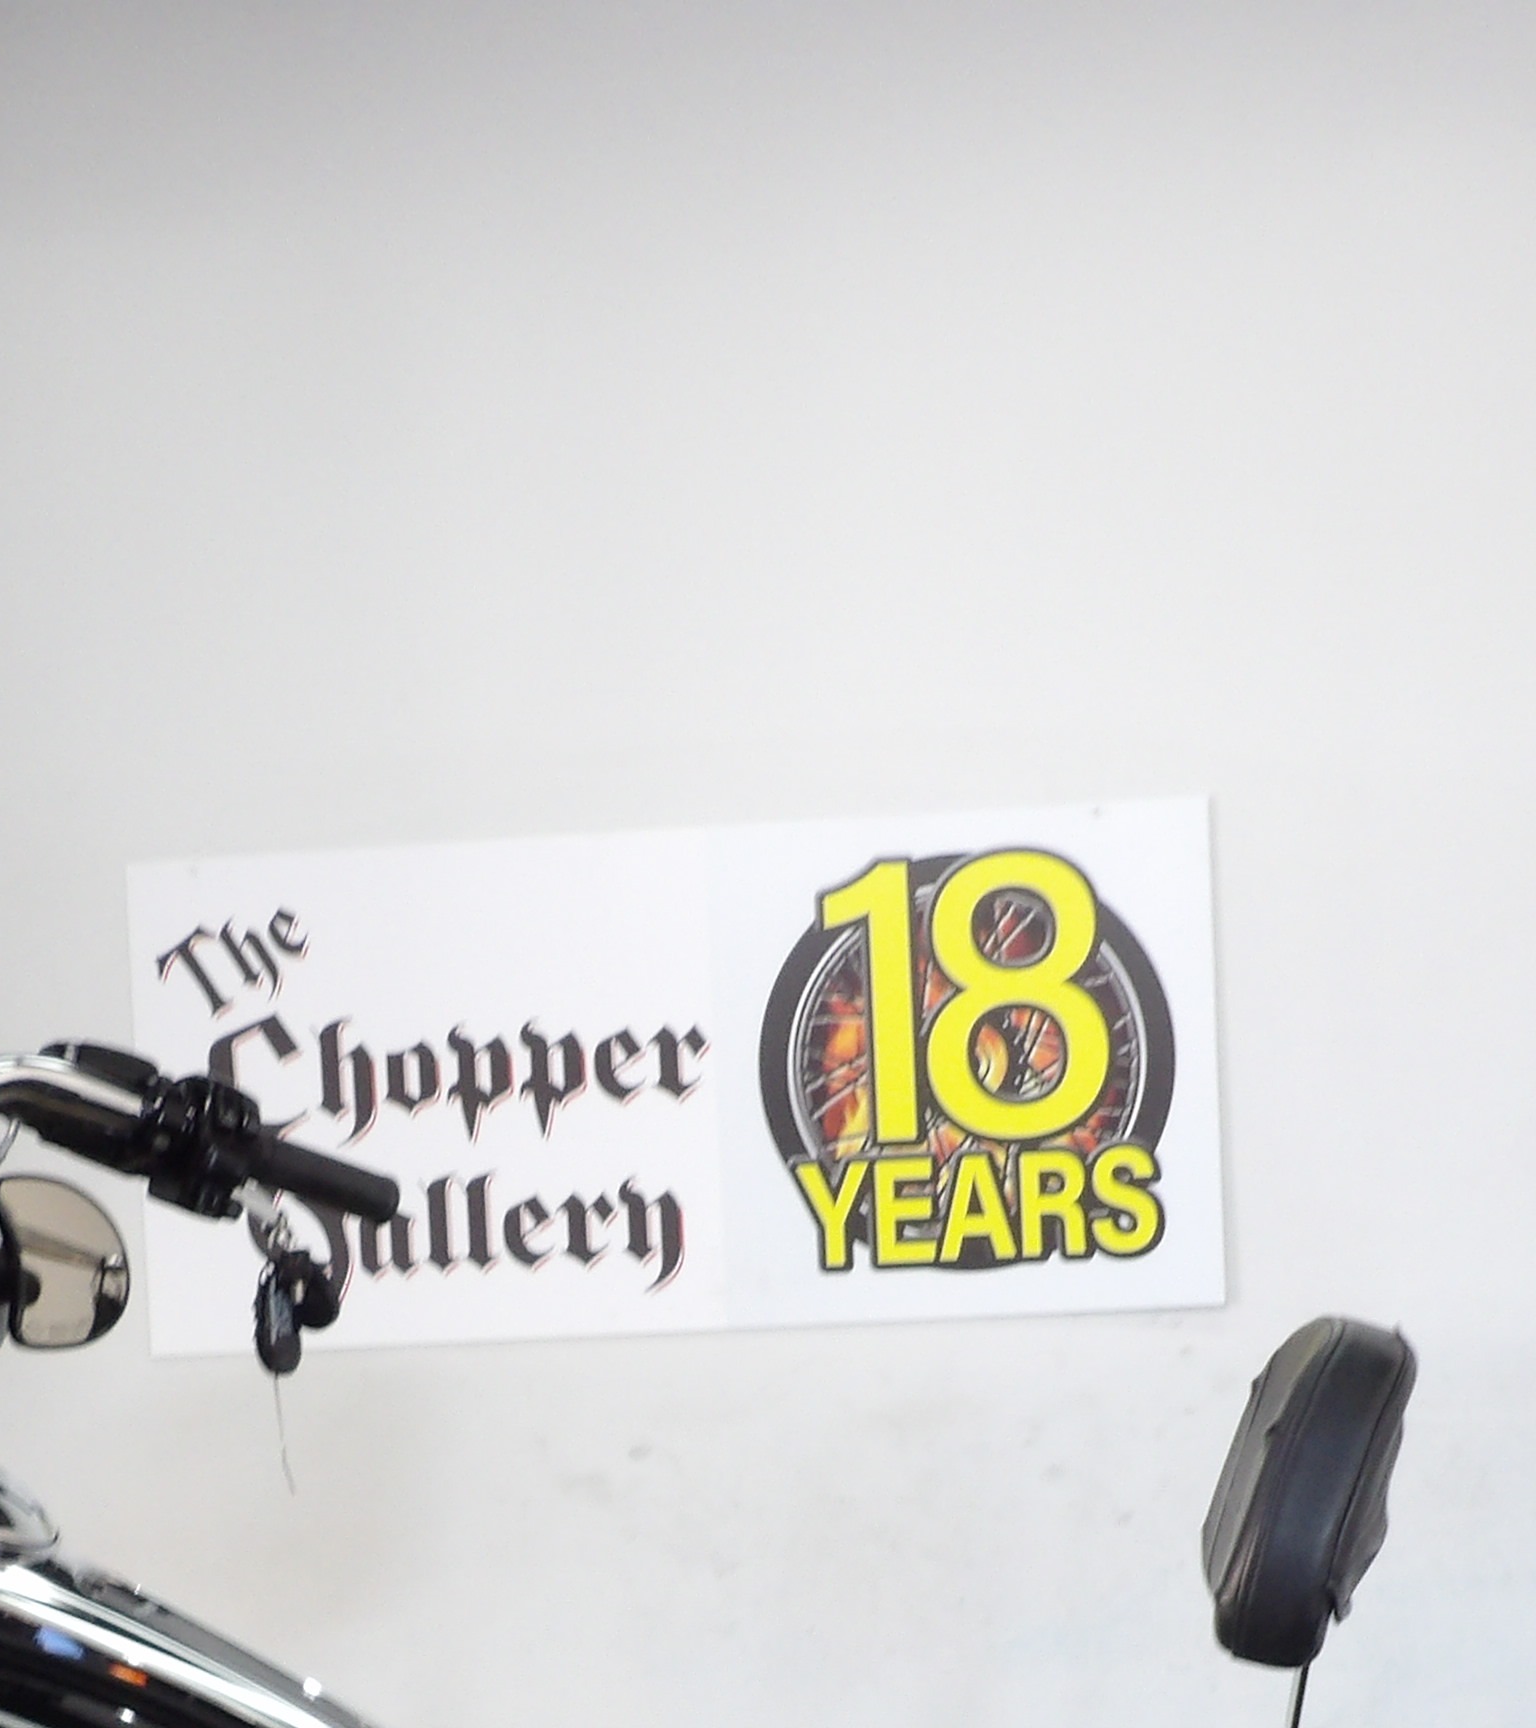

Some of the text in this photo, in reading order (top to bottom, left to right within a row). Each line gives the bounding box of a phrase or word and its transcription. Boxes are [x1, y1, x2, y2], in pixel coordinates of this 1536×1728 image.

[156, 905, 312, 1017] The
[814, 846, 1107, 1146] 18
[208, 1013, 711, 1143] Chopper
[796, 1142, 1166, 1273] YEARS
